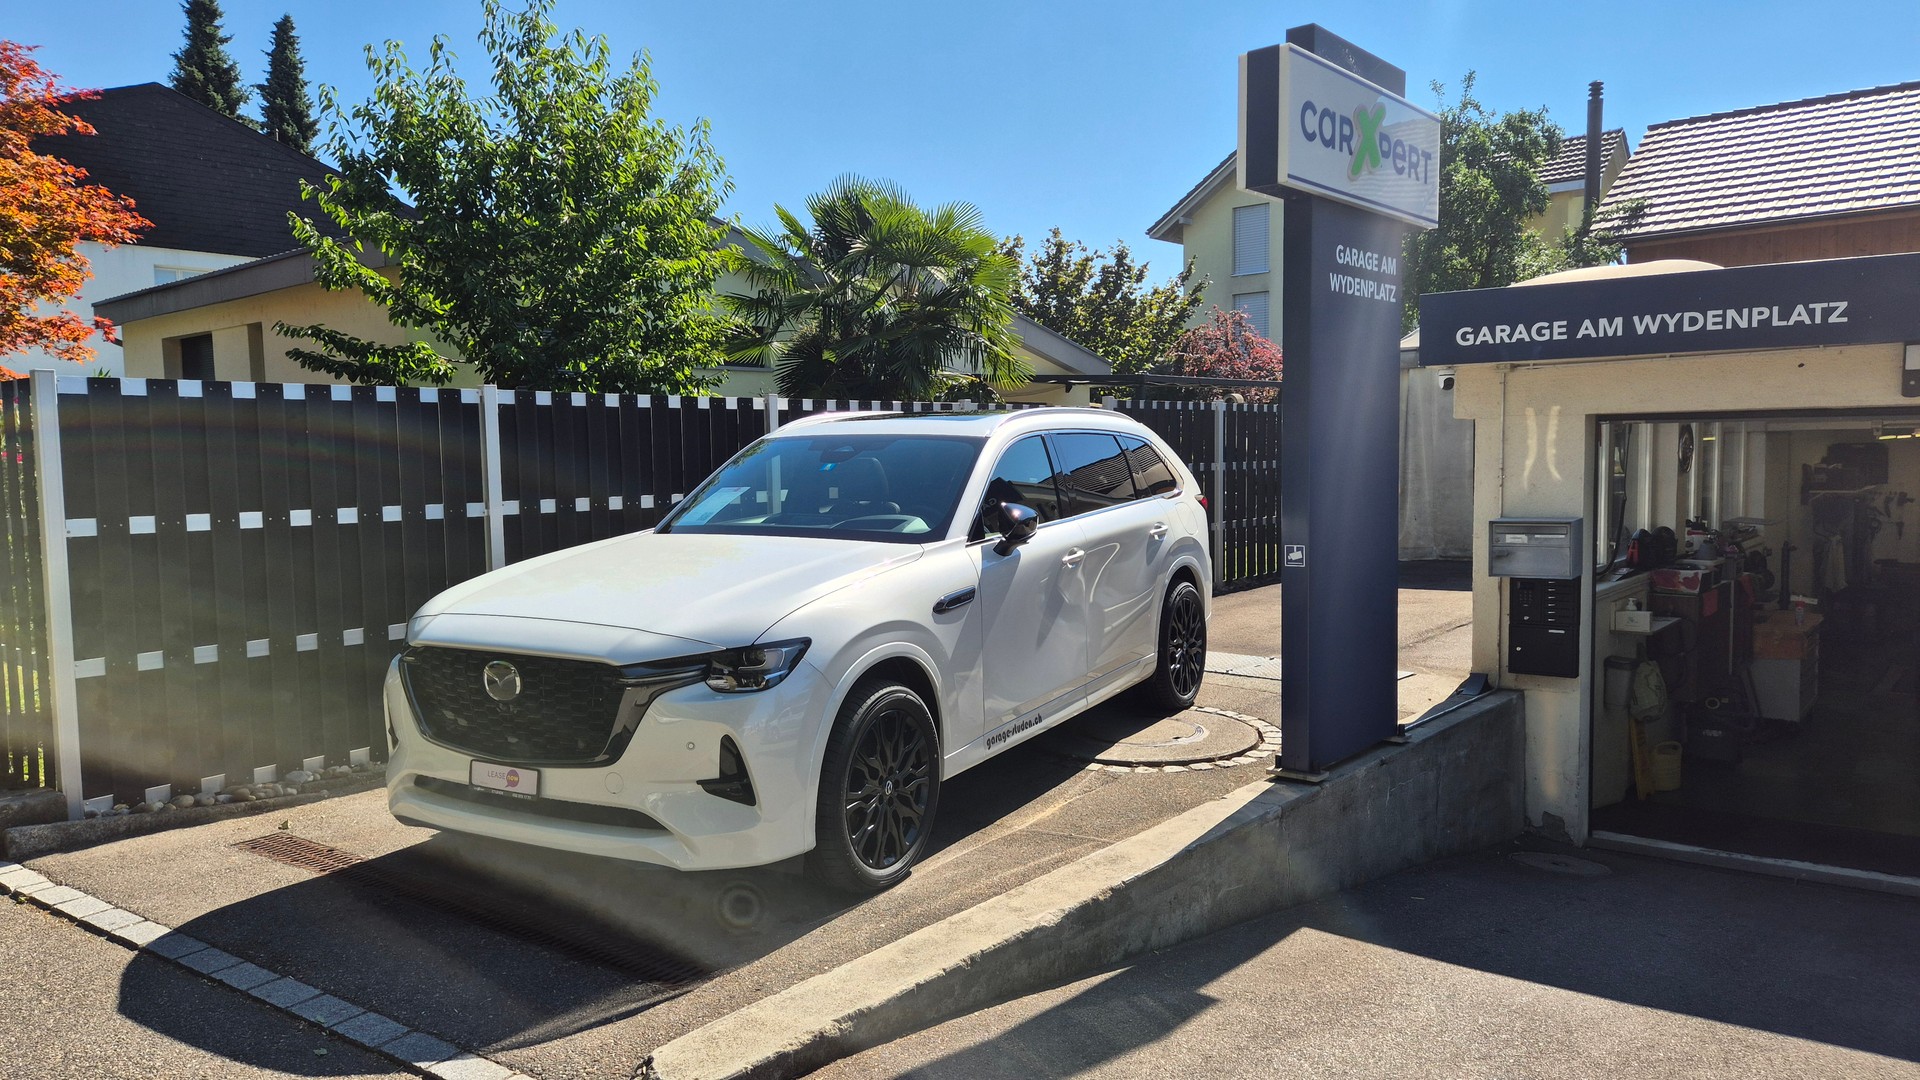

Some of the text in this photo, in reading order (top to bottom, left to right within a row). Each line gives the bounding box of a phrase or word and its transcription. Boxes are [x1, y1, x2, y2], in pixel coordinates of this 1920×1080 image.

[1336, 244, 1397, 276] GARAGE AM
[1329, 272, 1397, 303] WYDENPLATZ
[1455, 301, 1849, 346] GARAGE AM WYDENPLATZ
[487, 770, 506, 780] LEASE
